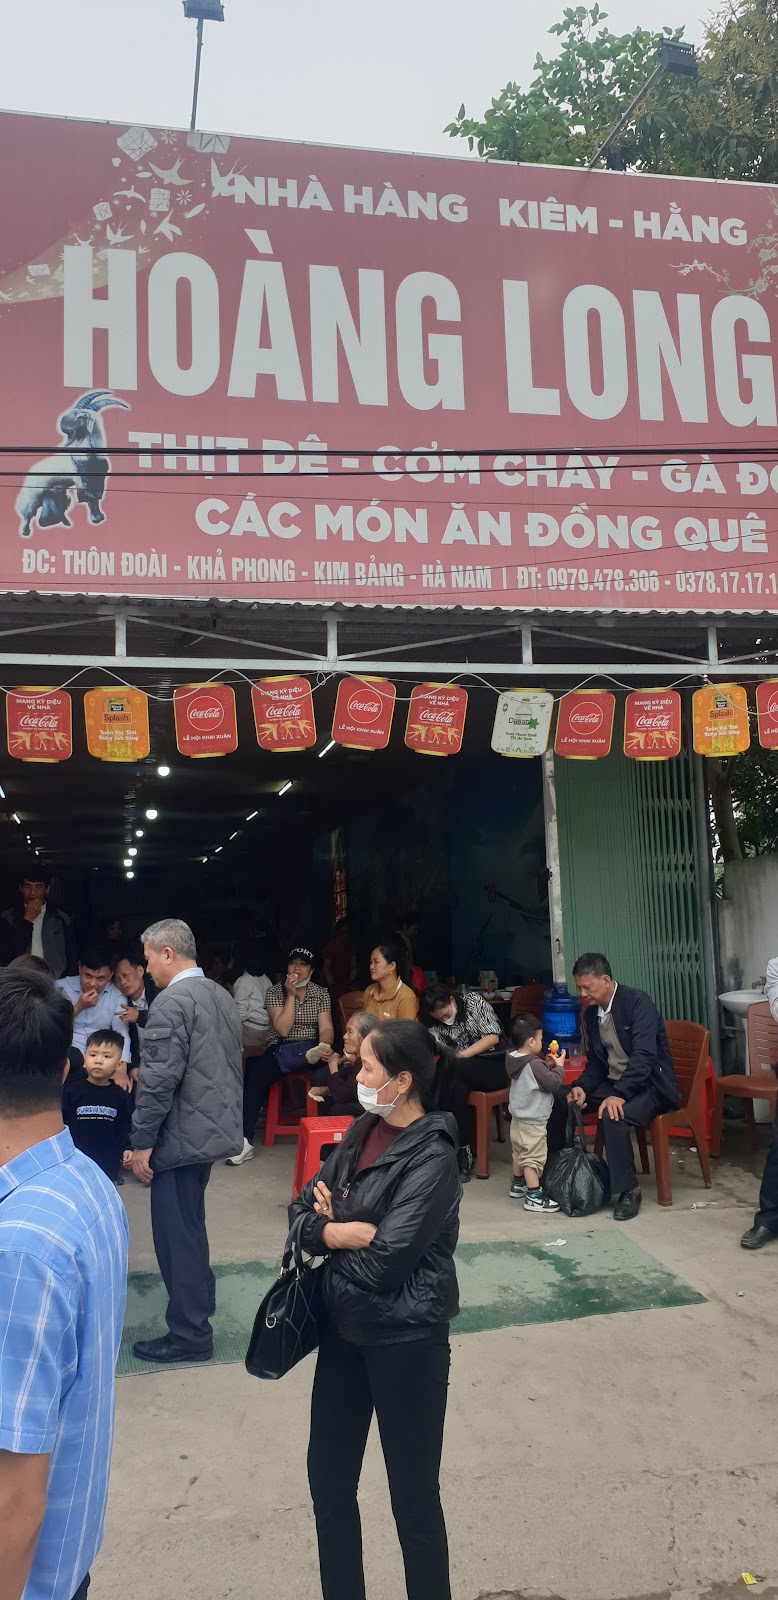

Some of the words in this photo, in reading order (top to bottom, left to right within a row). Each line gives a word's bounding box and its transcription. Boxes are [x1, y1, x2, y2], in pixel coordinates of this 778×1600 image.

[235, 175, 333, 211] NHÀ
[344, 182, 468, 223] HÀNG
[499, 197, 598, 234] KIÊM
[634, 202, 747, 246] HẰNG
[64, 228, 465, 410] HOÀNG
[503, 280, 777, 428] LONG
[128, 432, 248, 479] THỊT
[263, 434, 328, 477] DÊ
[373, 441, 481, 483] CƠM
[660, 454, 726, 494] GÀ
[195, 492, 301, 539] CÁC
[315, 498, 428, 543] MÓN
[441, 503, 512, 546] ĂN
[524, 502, 662, 550] ĐỒNG
[674, 512, 768, 553] QUÊ
[22, 549, 56, 574] ĐC:
[62, 546, 114, 576] THÔN
[121, 548, 167, 577] ĐOÀI
[187, 549, 226, 580] KHẢ
[232, 557, 296, 583] PHONG
[314, 561, 349, 585] KIM
[355, 555, 404, 586] BẢNG
[422, 560, 446, 588] HÀ
[451, 565, 491, 589] NAM
[517, 566, 542, 590] ĐT:
[547, 568, 659, 592] 0979.478.306
[266, 704, 302, 718] Coca-Cola
[350, 700, 380, 712] Coca-Cola
[104, 714, 128, 723] Splash
[190, 708, 221, 719] Coca-Cola
[420, 710, 456, 723] Coca-Cola
[571, 713, 601, 723] Coca-Cola
[20, 715, 60, 728] Coca-Cola
[636, 715, 671, 727] Coca-Cola
